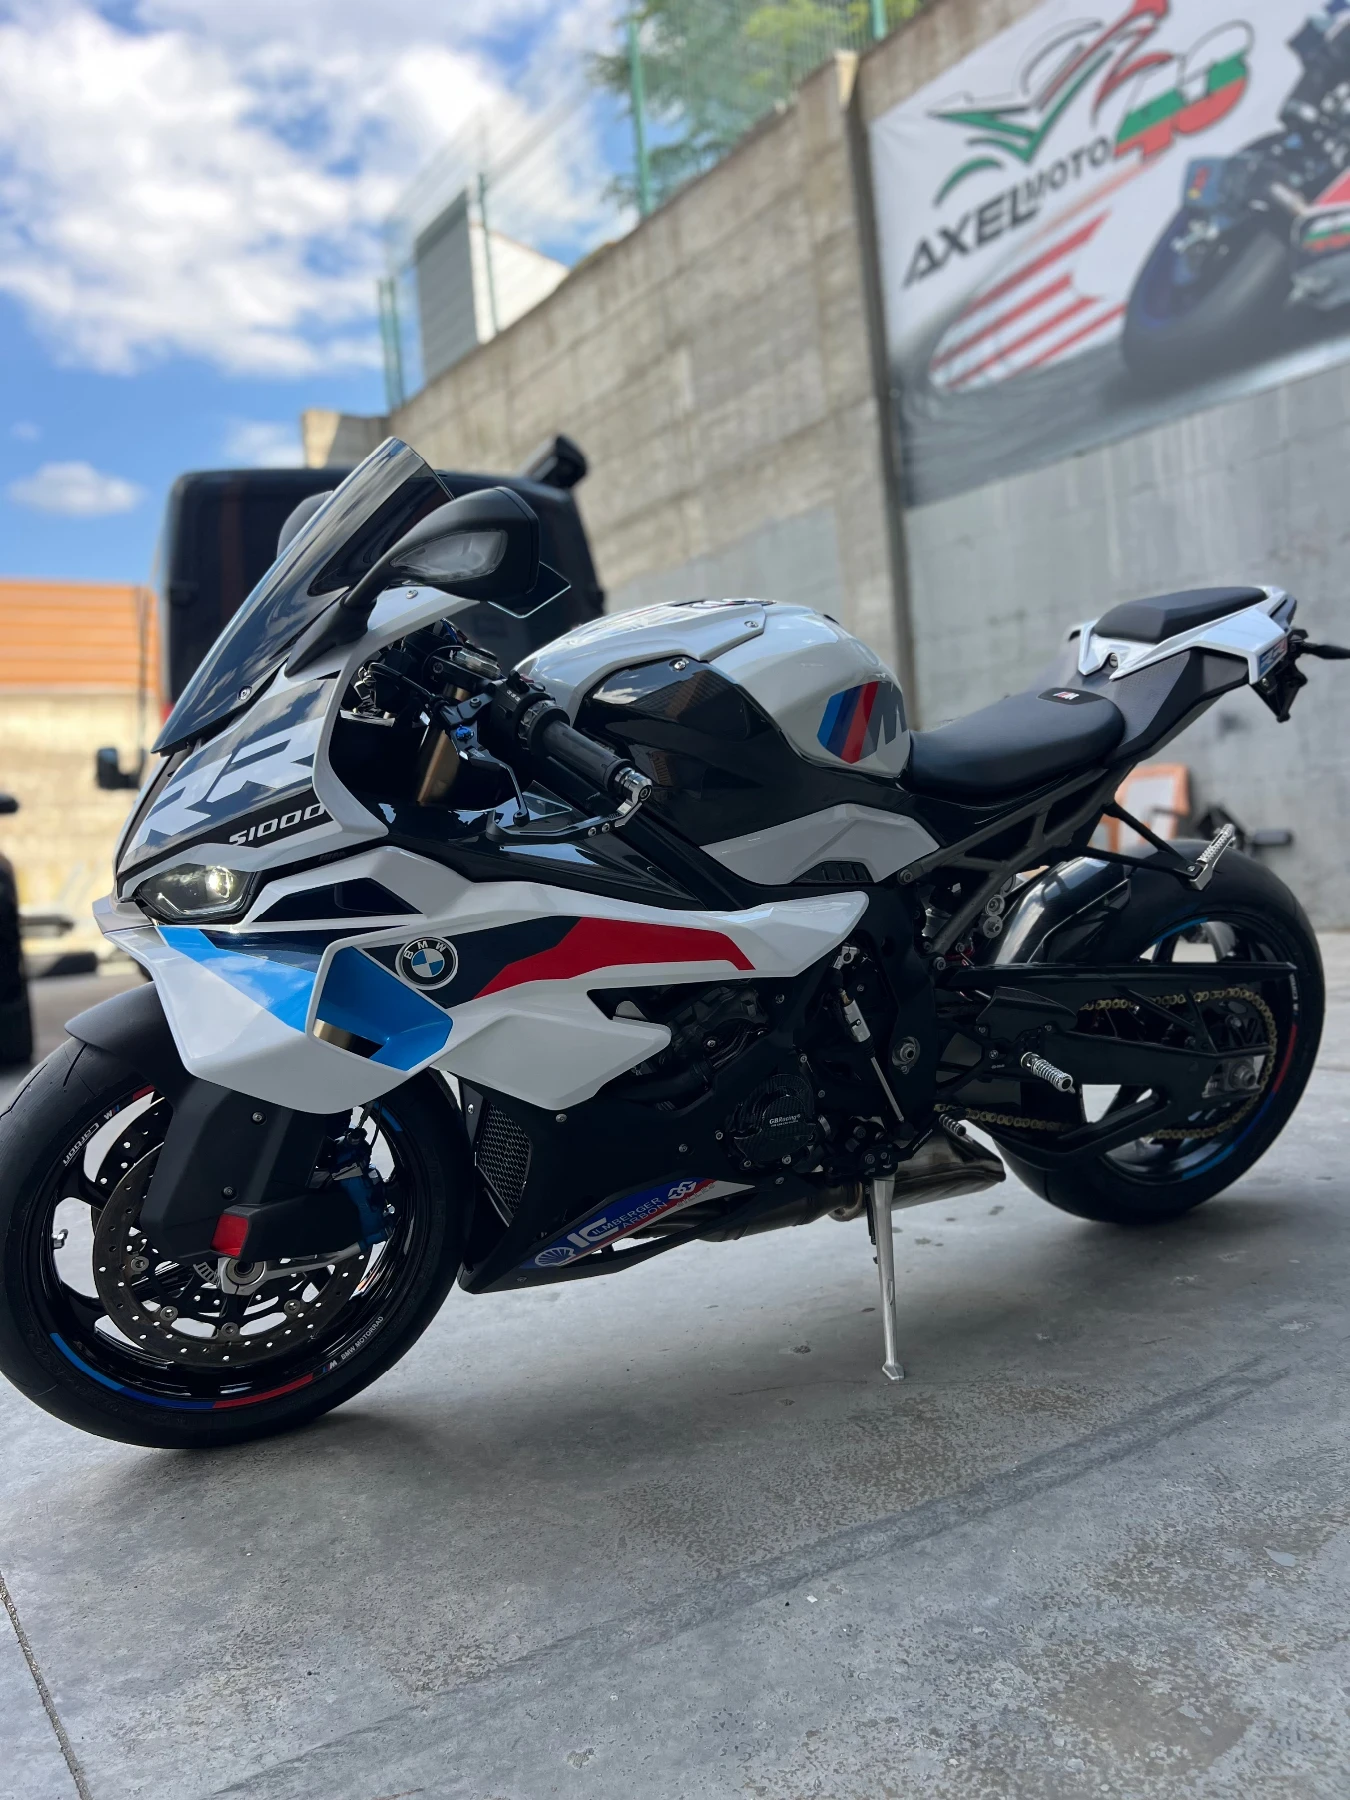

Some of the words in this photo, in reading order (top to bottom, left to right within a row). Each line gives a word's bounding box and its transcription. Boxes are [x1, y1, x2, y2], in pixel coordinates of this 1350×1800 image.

[228, 802, 327, 847] S1000
[591, 1197, 662, 1236] ILMBERGER
[340, 1345, 356, 1360] BMW
[354, 1316, 384, 1348] MOTORRAD
